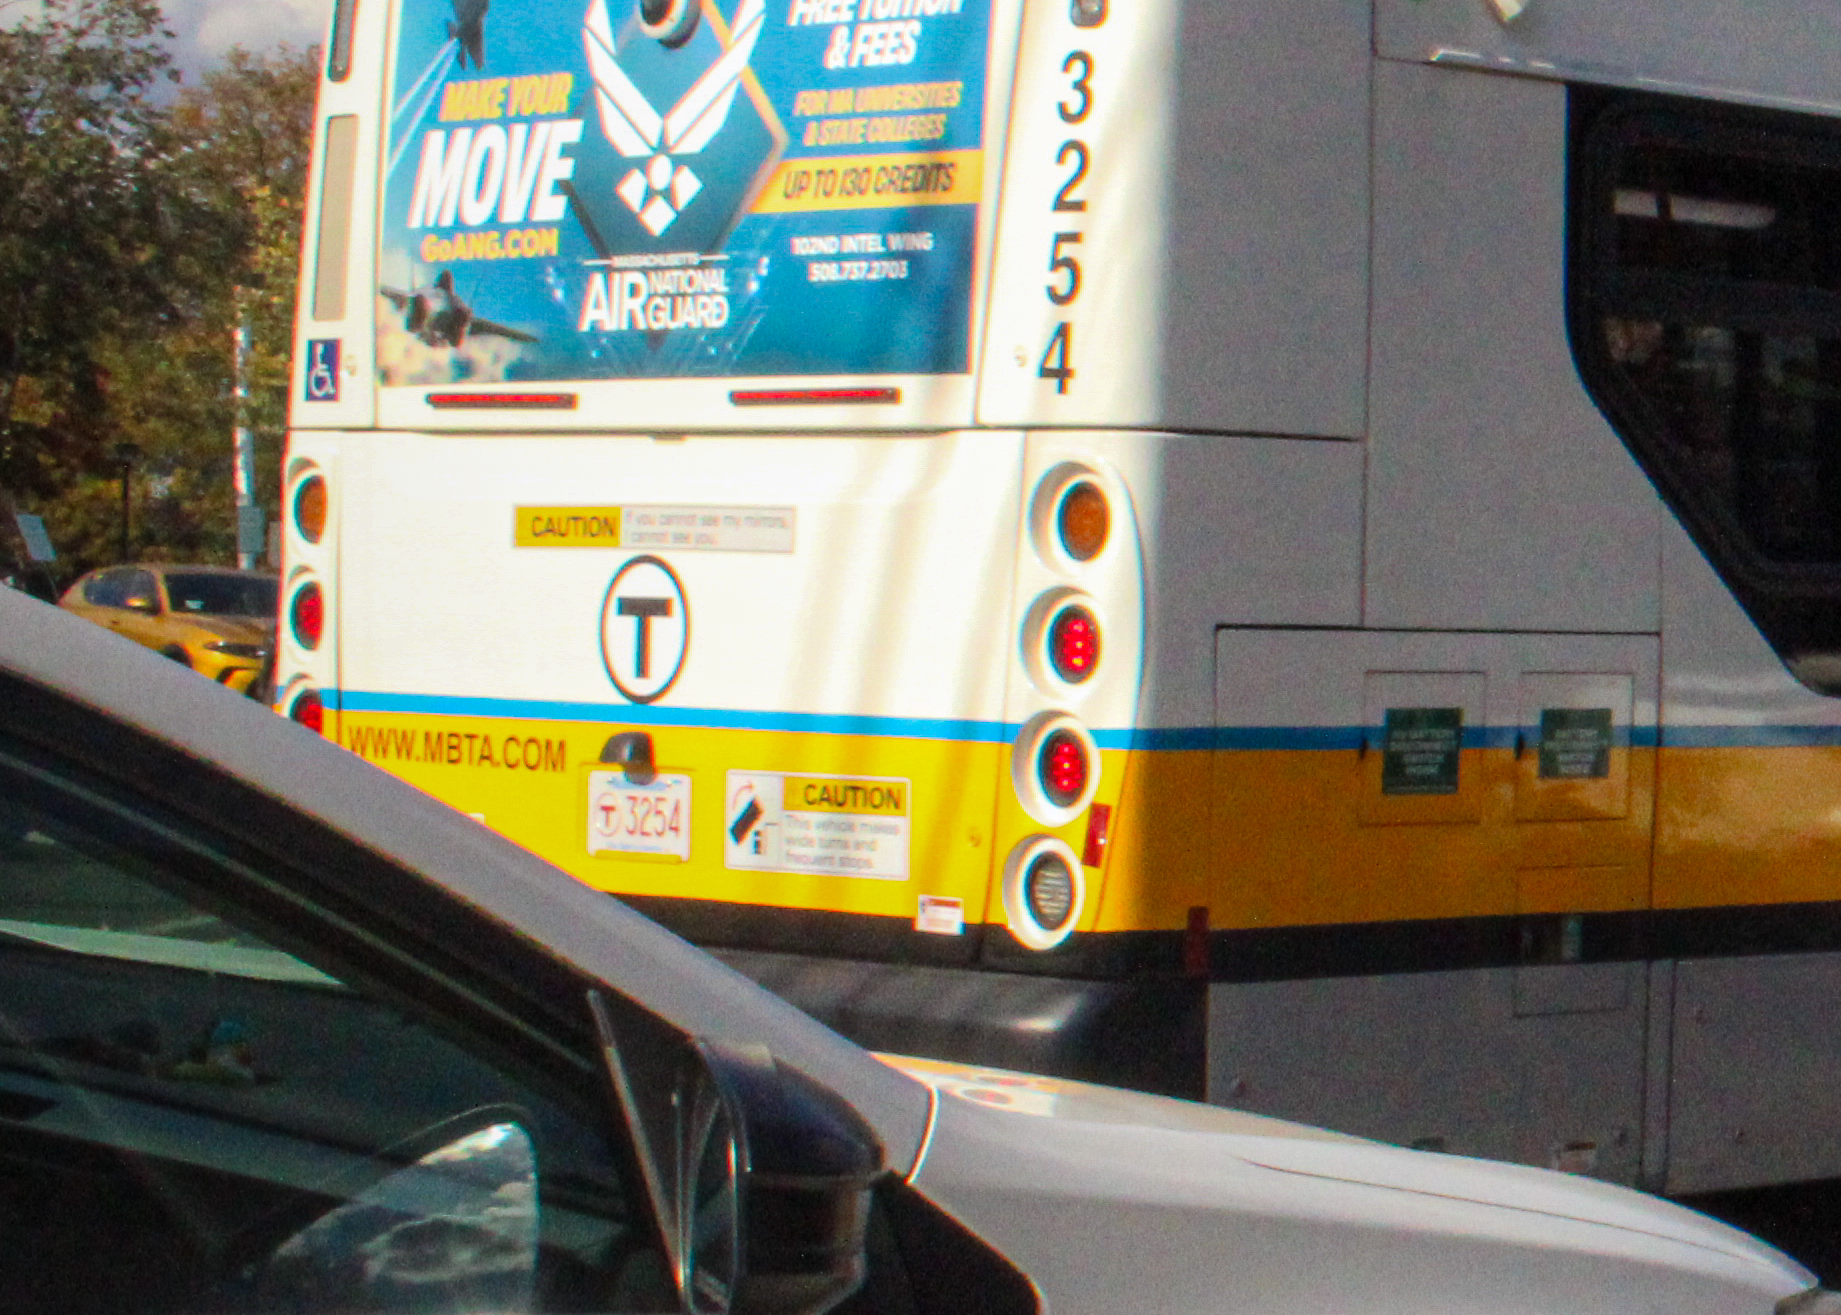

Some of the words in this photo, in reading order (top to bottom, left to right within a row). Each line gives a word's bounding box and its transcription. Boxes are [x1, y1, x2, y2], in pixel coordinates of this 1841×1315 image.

[824, 25, 849, 69] &
[848, 19, 922, 68] FEES
[439, 78, 509, 122] MAKE
[508, 73, 573, 116] YOUR
[793, 90, 828, 116] FOR
[827, 88, 854, 114] MA
[855, 81, 963, 112] UNIVERSITIES
[803, 121, 818, 146] &
[818, 118, 868, 145] STATE
[866, 113, 947, 143] COLLEGES
[407, 119, 584, 228] MOVE
[784, 170, 811, 199] UP
[813, 168, 837, 197] TO
[839, 167, 871, 196] 130
[874, 162, 956, 194] CREDITS
[840, 233, 887, 253] INTEL
[886, 231, 935, 251] WING
[1036, 49, 1094, 395] 3254
[649, 268, 730, 293] NATIONAL
[578, 271, 648, 332] AIR
[645, 294, 730, 330] GUARD
[532, 516, 617, 538] CAUTION
[616, 596, 673, 679] T
[348, 725, 568, 772] WWW.MBTA.COM
[803, 783, 901, 809] CAUTION
[626, 795, 681, 838] 3254
